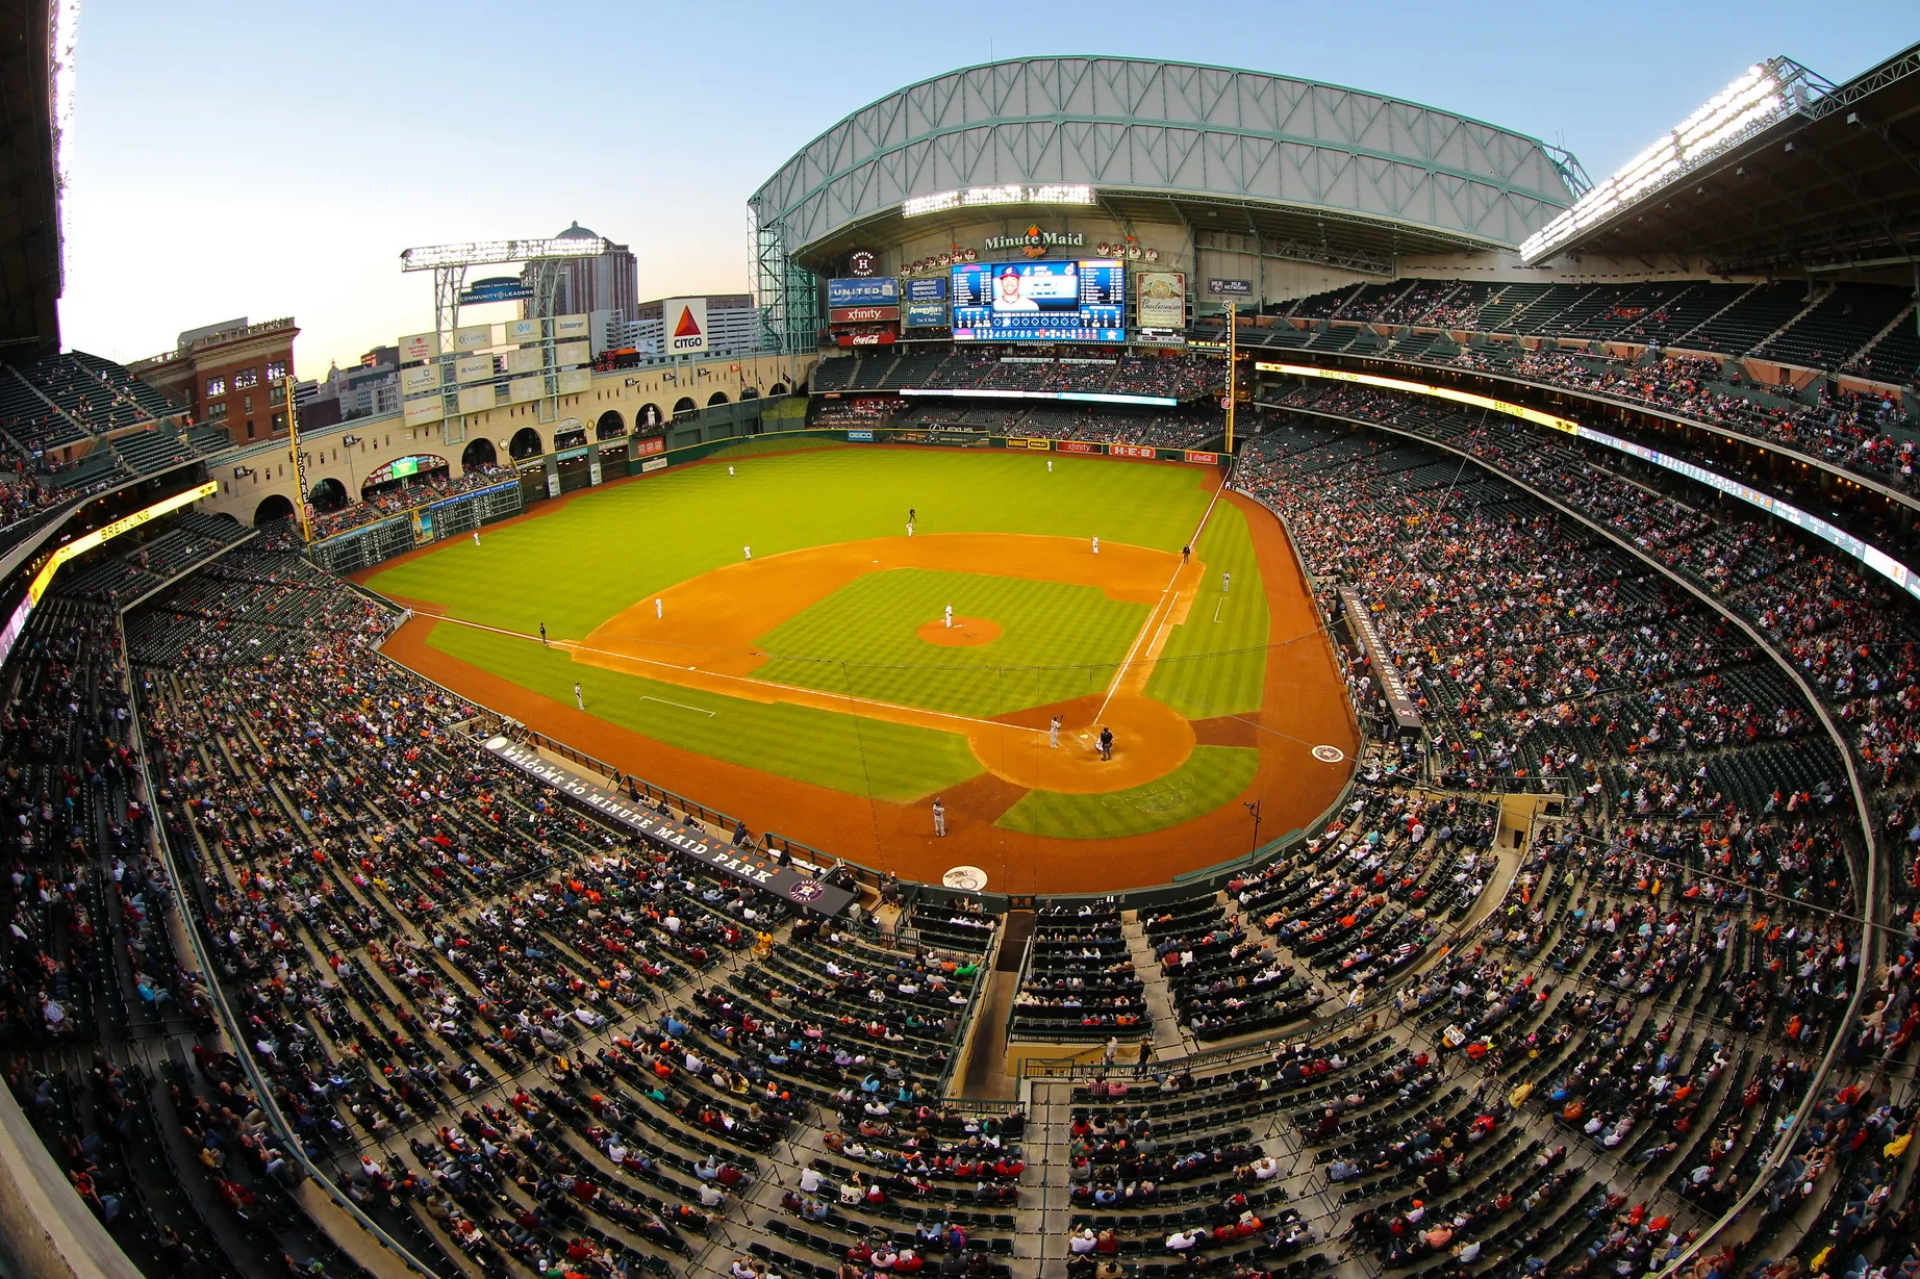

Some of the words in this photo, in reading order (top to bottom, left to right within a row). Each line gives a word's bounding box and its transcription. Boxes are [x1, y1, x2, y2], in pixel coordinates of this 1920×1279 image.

[985, 234, 1040, 250] Minute
[1042, 232, 1084, 246] Maid
[858, 259, 868, 269] H
[459, 293, 497, 302] COMMUNITY
[504, 289, 534, 297] LEADERS
[834, 287, 880, 296] UNITED
[1141, 299, 1181, 310] Budweiser
[848, 309, 881, 320] xfinity
[467, 334, 487, 342] CALPINE
[674, 337, 702, 349] CITGO
[852, 335, 880, 346] Coca-Cola
[468, 364, 488, 373] NABORS
[1319, 369, 1359, 382] BREITLING
[407, 376, 435, 387] CHAMPION
[405, 405, 442, 417] HALLIBURTON
[1067, 444, 1091, 452] xfinity
[100, 510, 150, 542] BREITLING
[1810, 516, 1825, 528] BALLS
[1389, 677, 1407, 700] HOME
[502, 747, 566, 785] WELCOME
[564, 781, 586, 795] TO
[587, 793, 653, 830] MINUTE
[654, 826, 709, 855] MAID
[711, 852, 774, 884] PARK
[608, 795, 687, 834] HOUSTON
[700, 837, 781, 875] ASTROS
[801, 879, 824, 891] HOUSTON
[790, 891, 811, 901] ASTROS
[841, 1194, 854, 1203] 24
